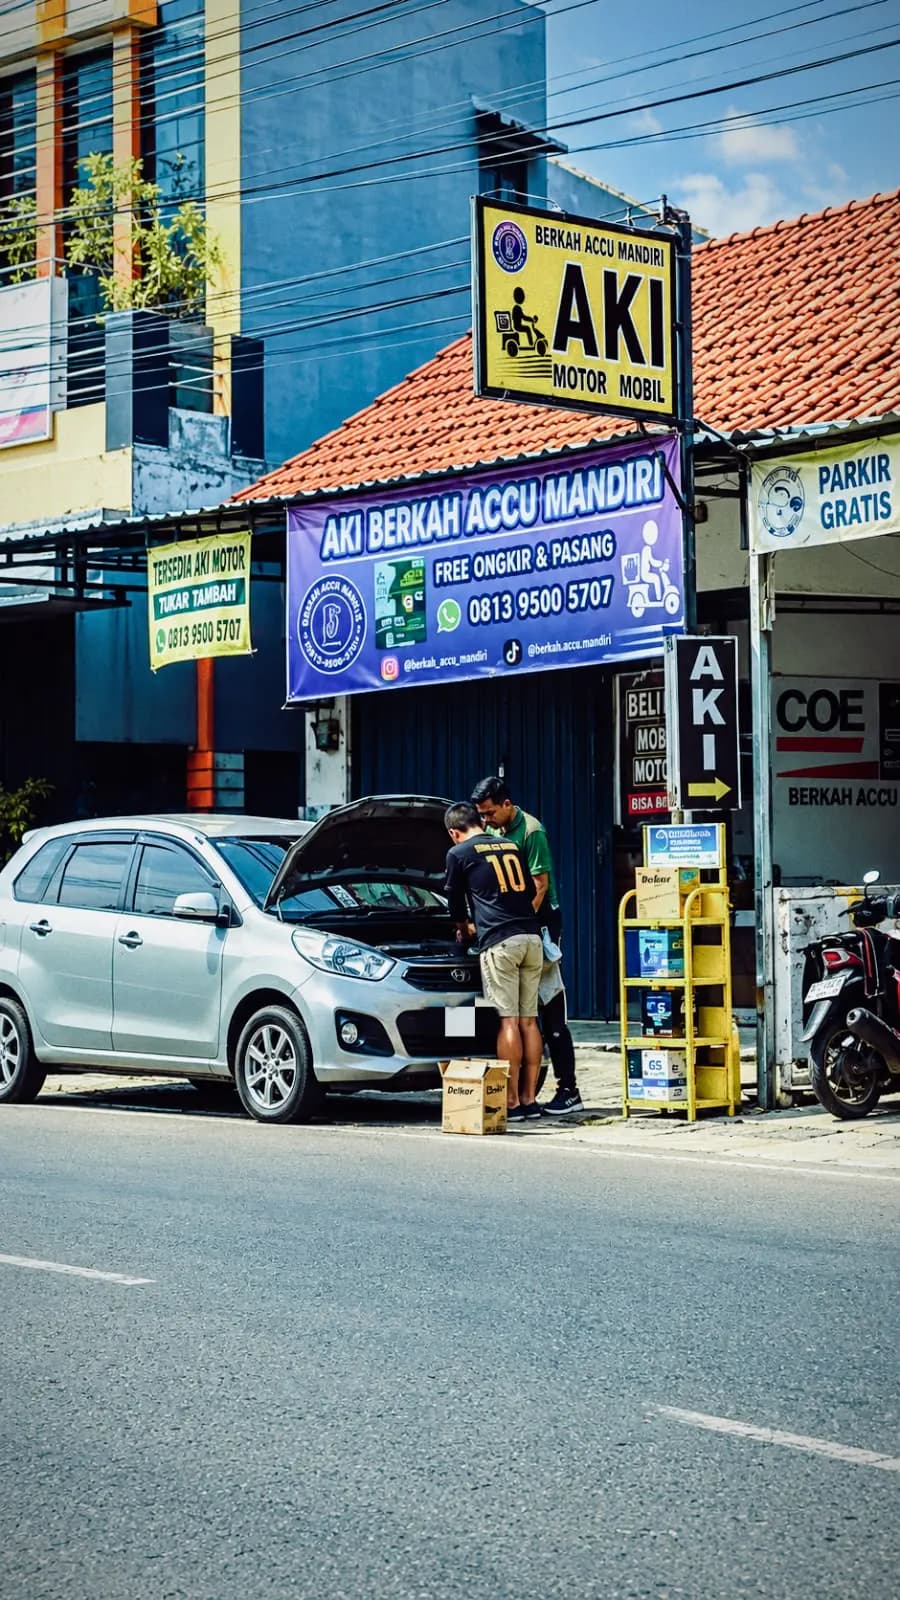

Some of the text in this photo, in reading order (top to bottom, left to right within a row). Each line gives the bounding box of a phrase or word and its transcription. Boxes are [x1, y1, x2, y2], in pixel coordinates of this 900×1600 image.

[535, 224, 581, 253] BERKAH
[584, 234, 615, 258] ACCU
[618, 241, 665, 268] MANDIRI
[552, 262, 665, 369] AKI
[553, 363, 665, 404] MOTOR MOBIL
[818, 453, 892, 494] PARKIR
[320, 456, 662, 559] AKI BERKAH ACCU MANDIRI
[820, 490, 892, 530] GRATIS
[153, 545, 245, 586] TERSEDIA AKI MOTOR
[435, 533, 614, 584] FREE ONGKIR & PASANG
[159, 583, 237, 614] TUKAR TAMBAH
[469, 578, 612, 623] 0813 9500 5707
[168, 617, 241, 649] 0813 9500 5707
[628, 690, 661, 718] BELI
[776, 689, 865, 732] COE
[631, 796, 653, 810] BISA
[788, 786, 898, 807] BERKAH ACCU
[485, 853, 526, 893] 10
[648, 1059, 662, 1071] GS
